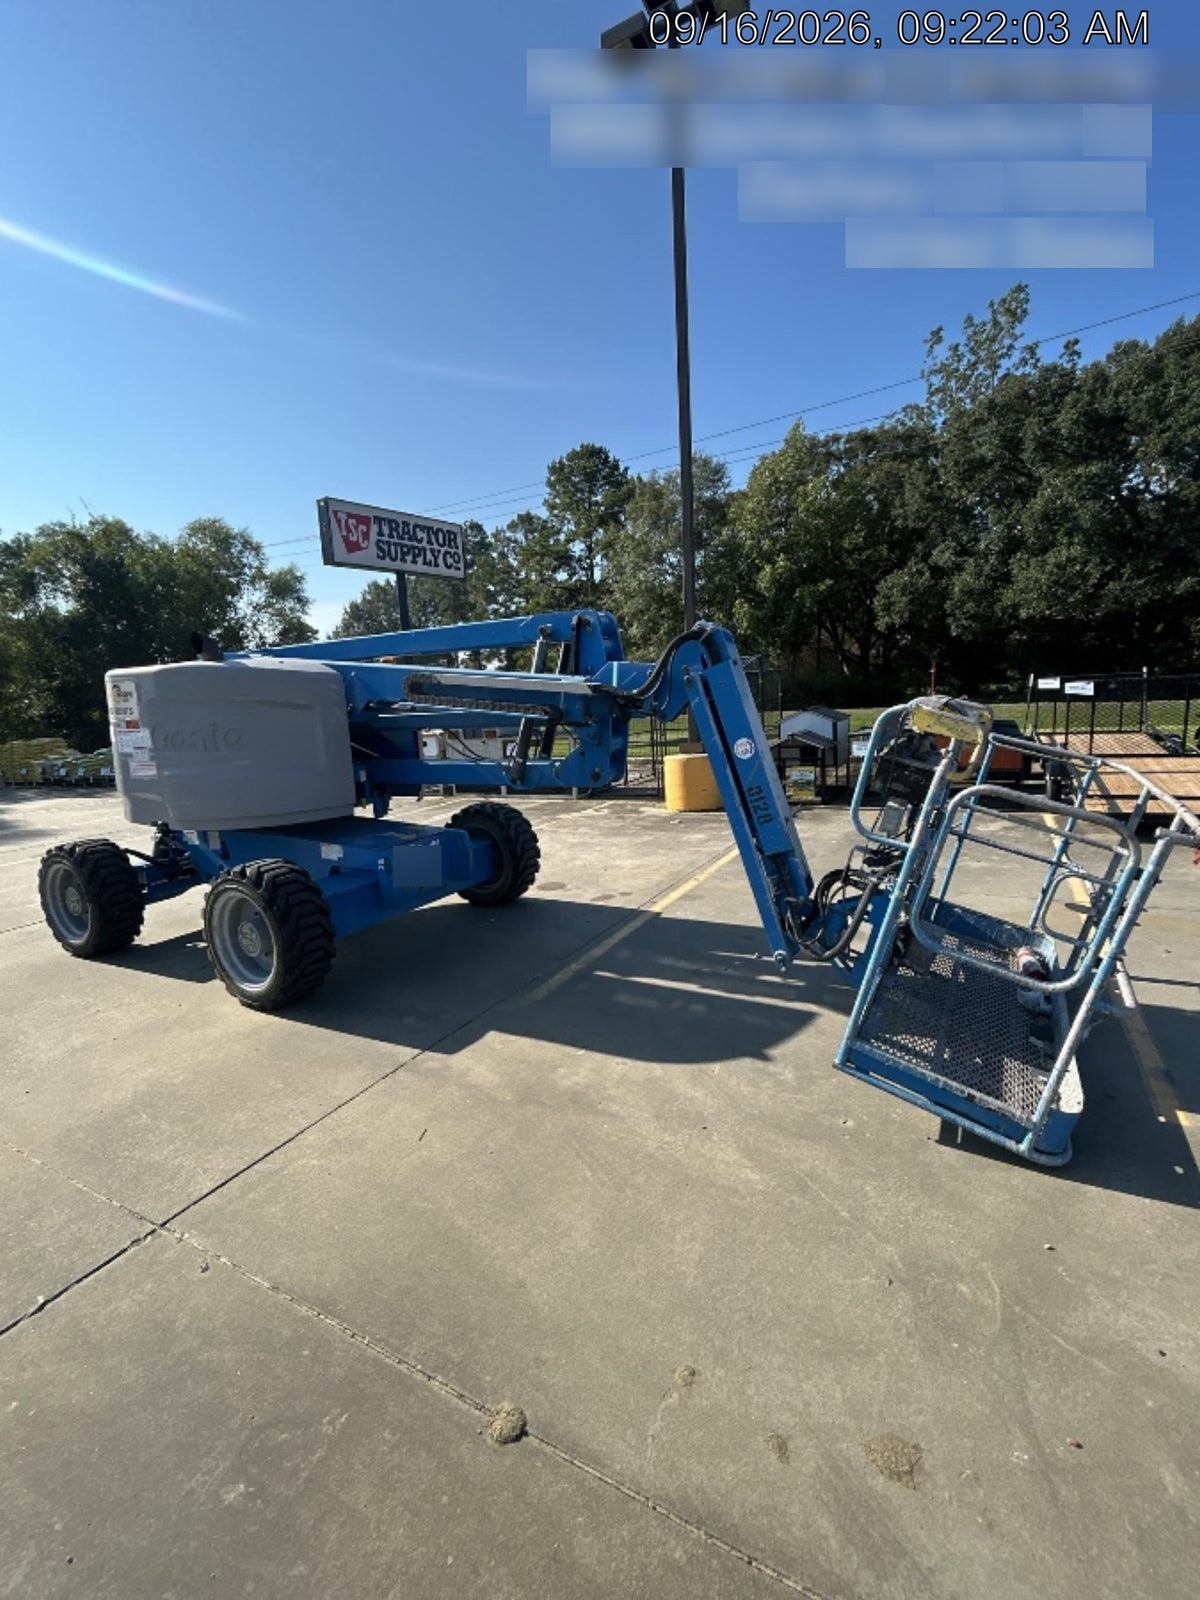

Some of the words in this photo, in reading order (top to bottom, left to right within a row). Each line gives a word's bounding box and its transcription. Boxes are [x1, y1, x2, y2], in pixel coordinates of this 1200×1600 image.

[337, 512, 369, 548] TSC
[373, 515, 459, 550] TRACTOR
[376, 538, 440, 568] SUPPLY
